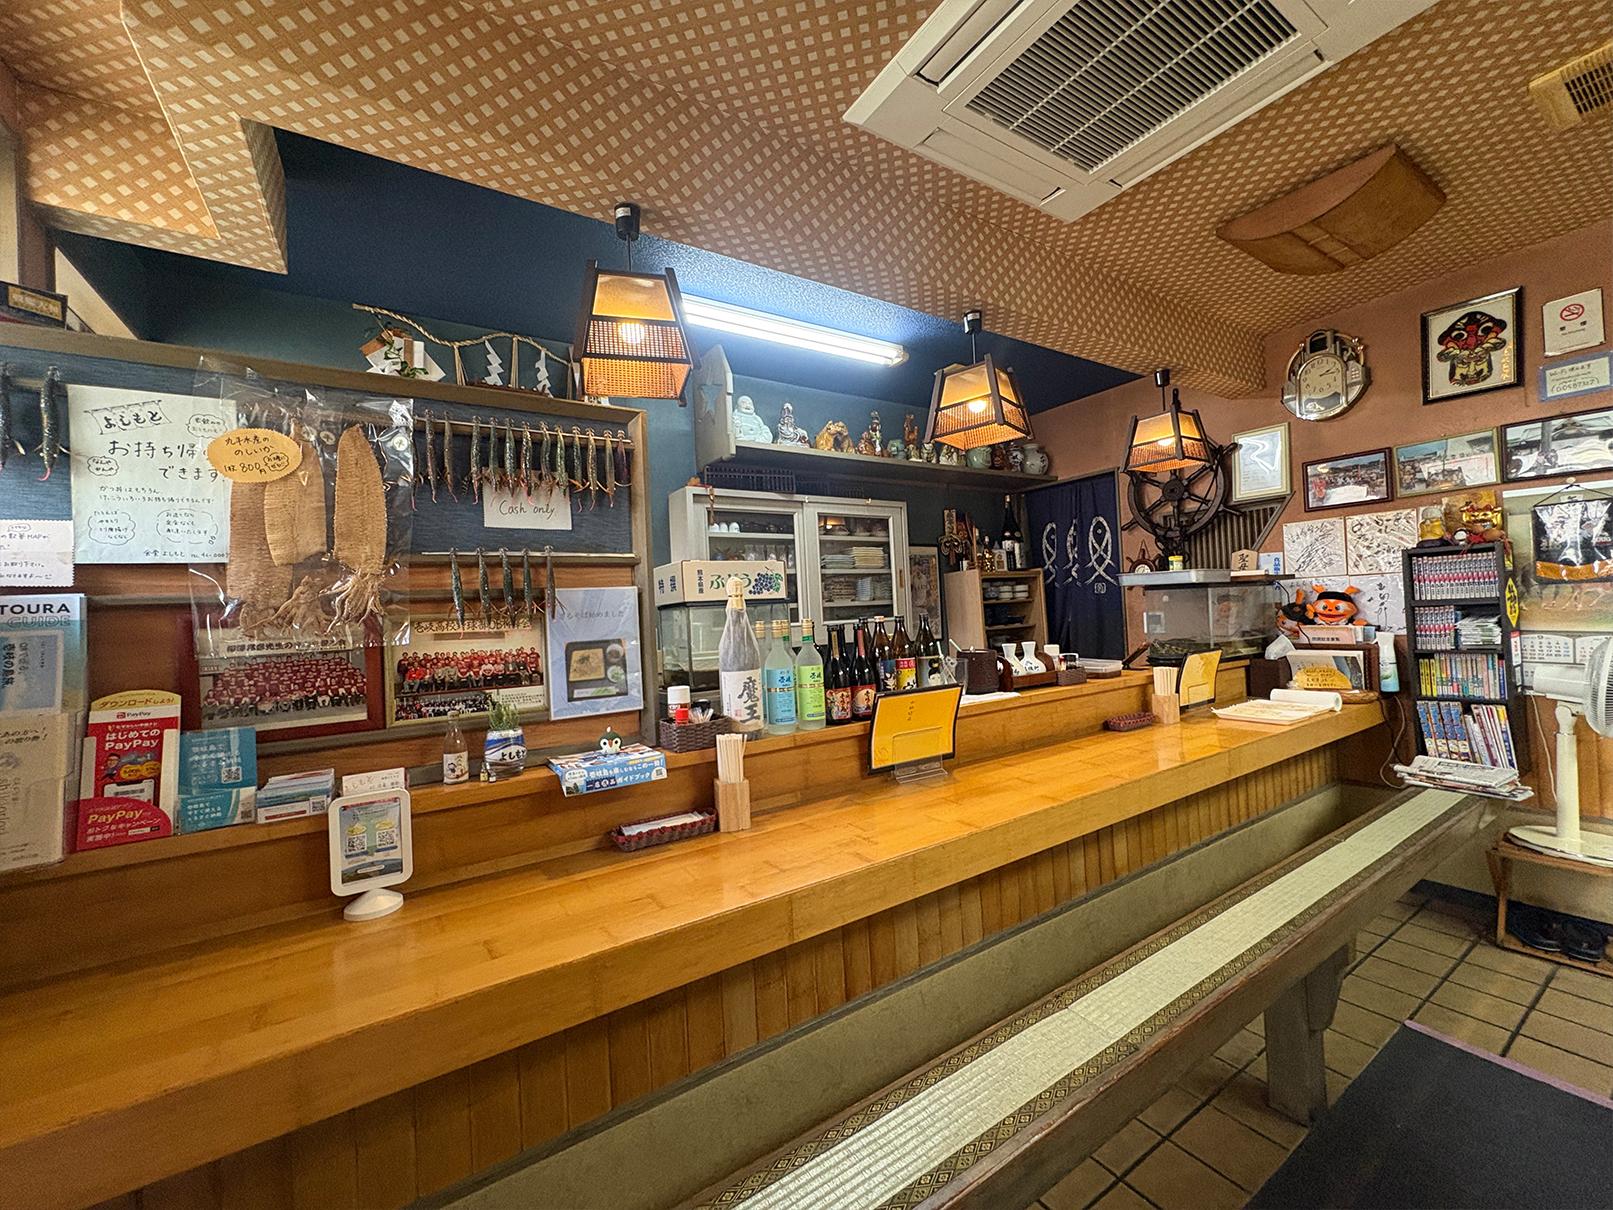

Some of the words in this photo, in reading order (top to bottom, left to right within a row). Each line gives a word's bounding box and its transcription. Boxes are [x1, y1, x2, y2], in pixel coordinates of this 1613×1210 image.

[104, 410, 162, 429] よしもと
[498, 499, 527, 516] Cash
[532, 502, 556, 520] only
[709, 572, 752, 591] ぶう
[7, 614, 72, 629] GUIDE
[737, 676, 761, 724] 魔王
[126, 710, 152, 719] PayPay
[105, 728, 161, 741] はじめての
[104, 738, 160, 752] PayPay
[87, 808, 145, 825] PayPay
